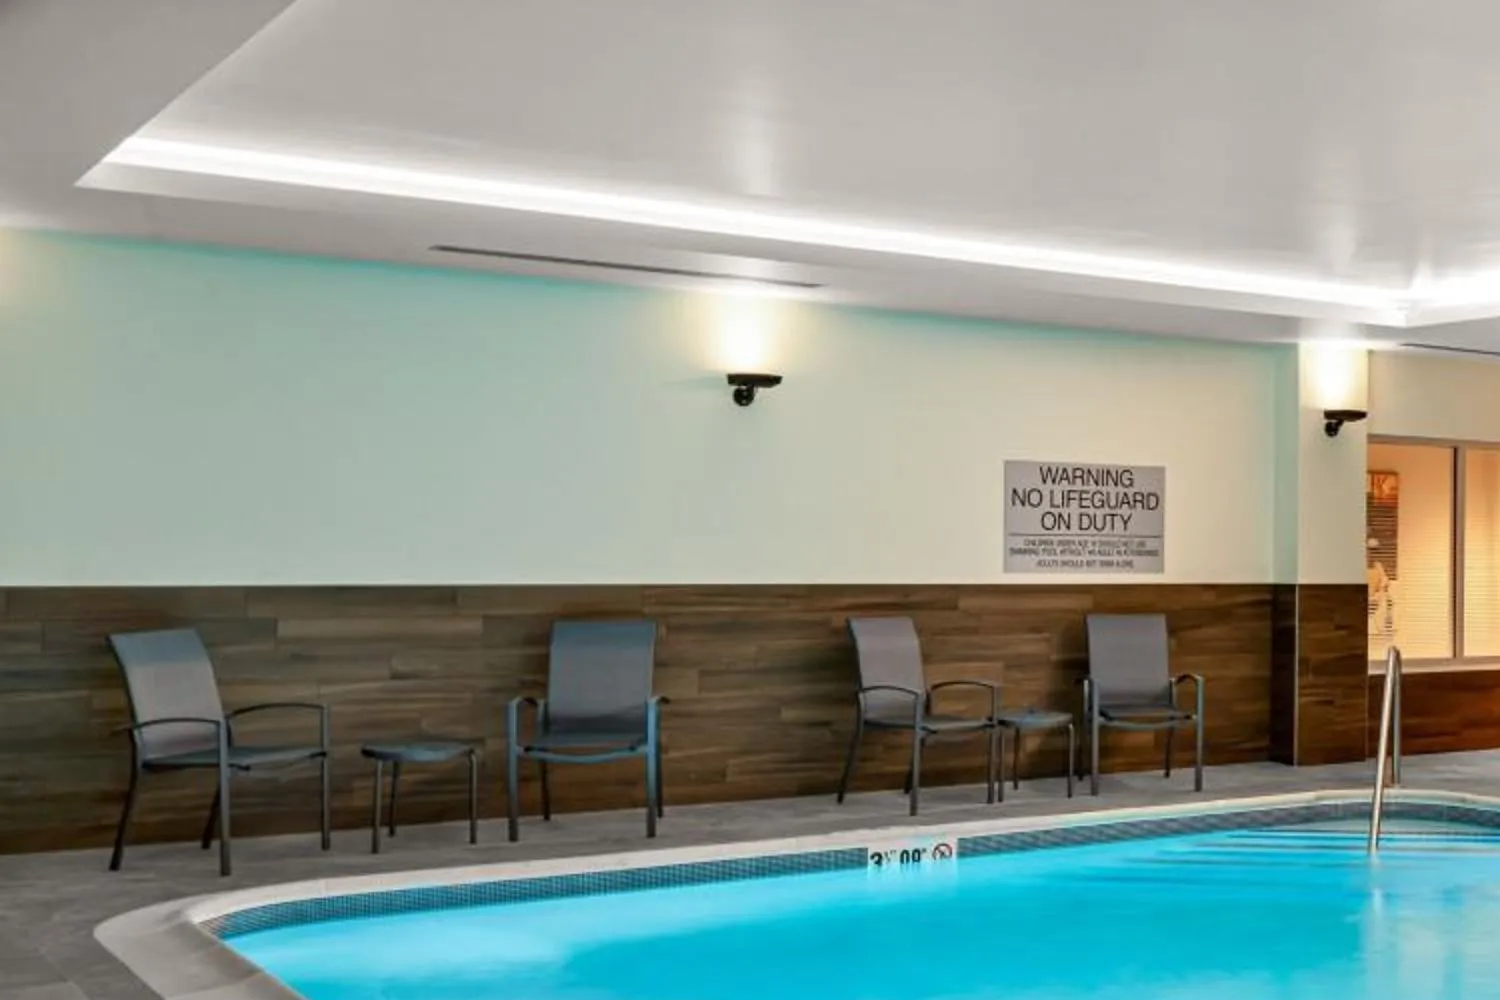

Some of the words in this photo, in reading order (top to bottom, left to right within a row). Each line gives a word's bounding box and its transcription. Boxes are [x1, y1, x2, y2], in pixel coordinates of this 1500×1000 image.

[1039, 466, 1135, 488] WARNING
[1011, 488, 1043, 508] NO
[1050, 489, 1160, 511] LIFEGUARD
[1041, 512, 1071, 531] ON
[1079, 513, 1133, 532] DUTY
